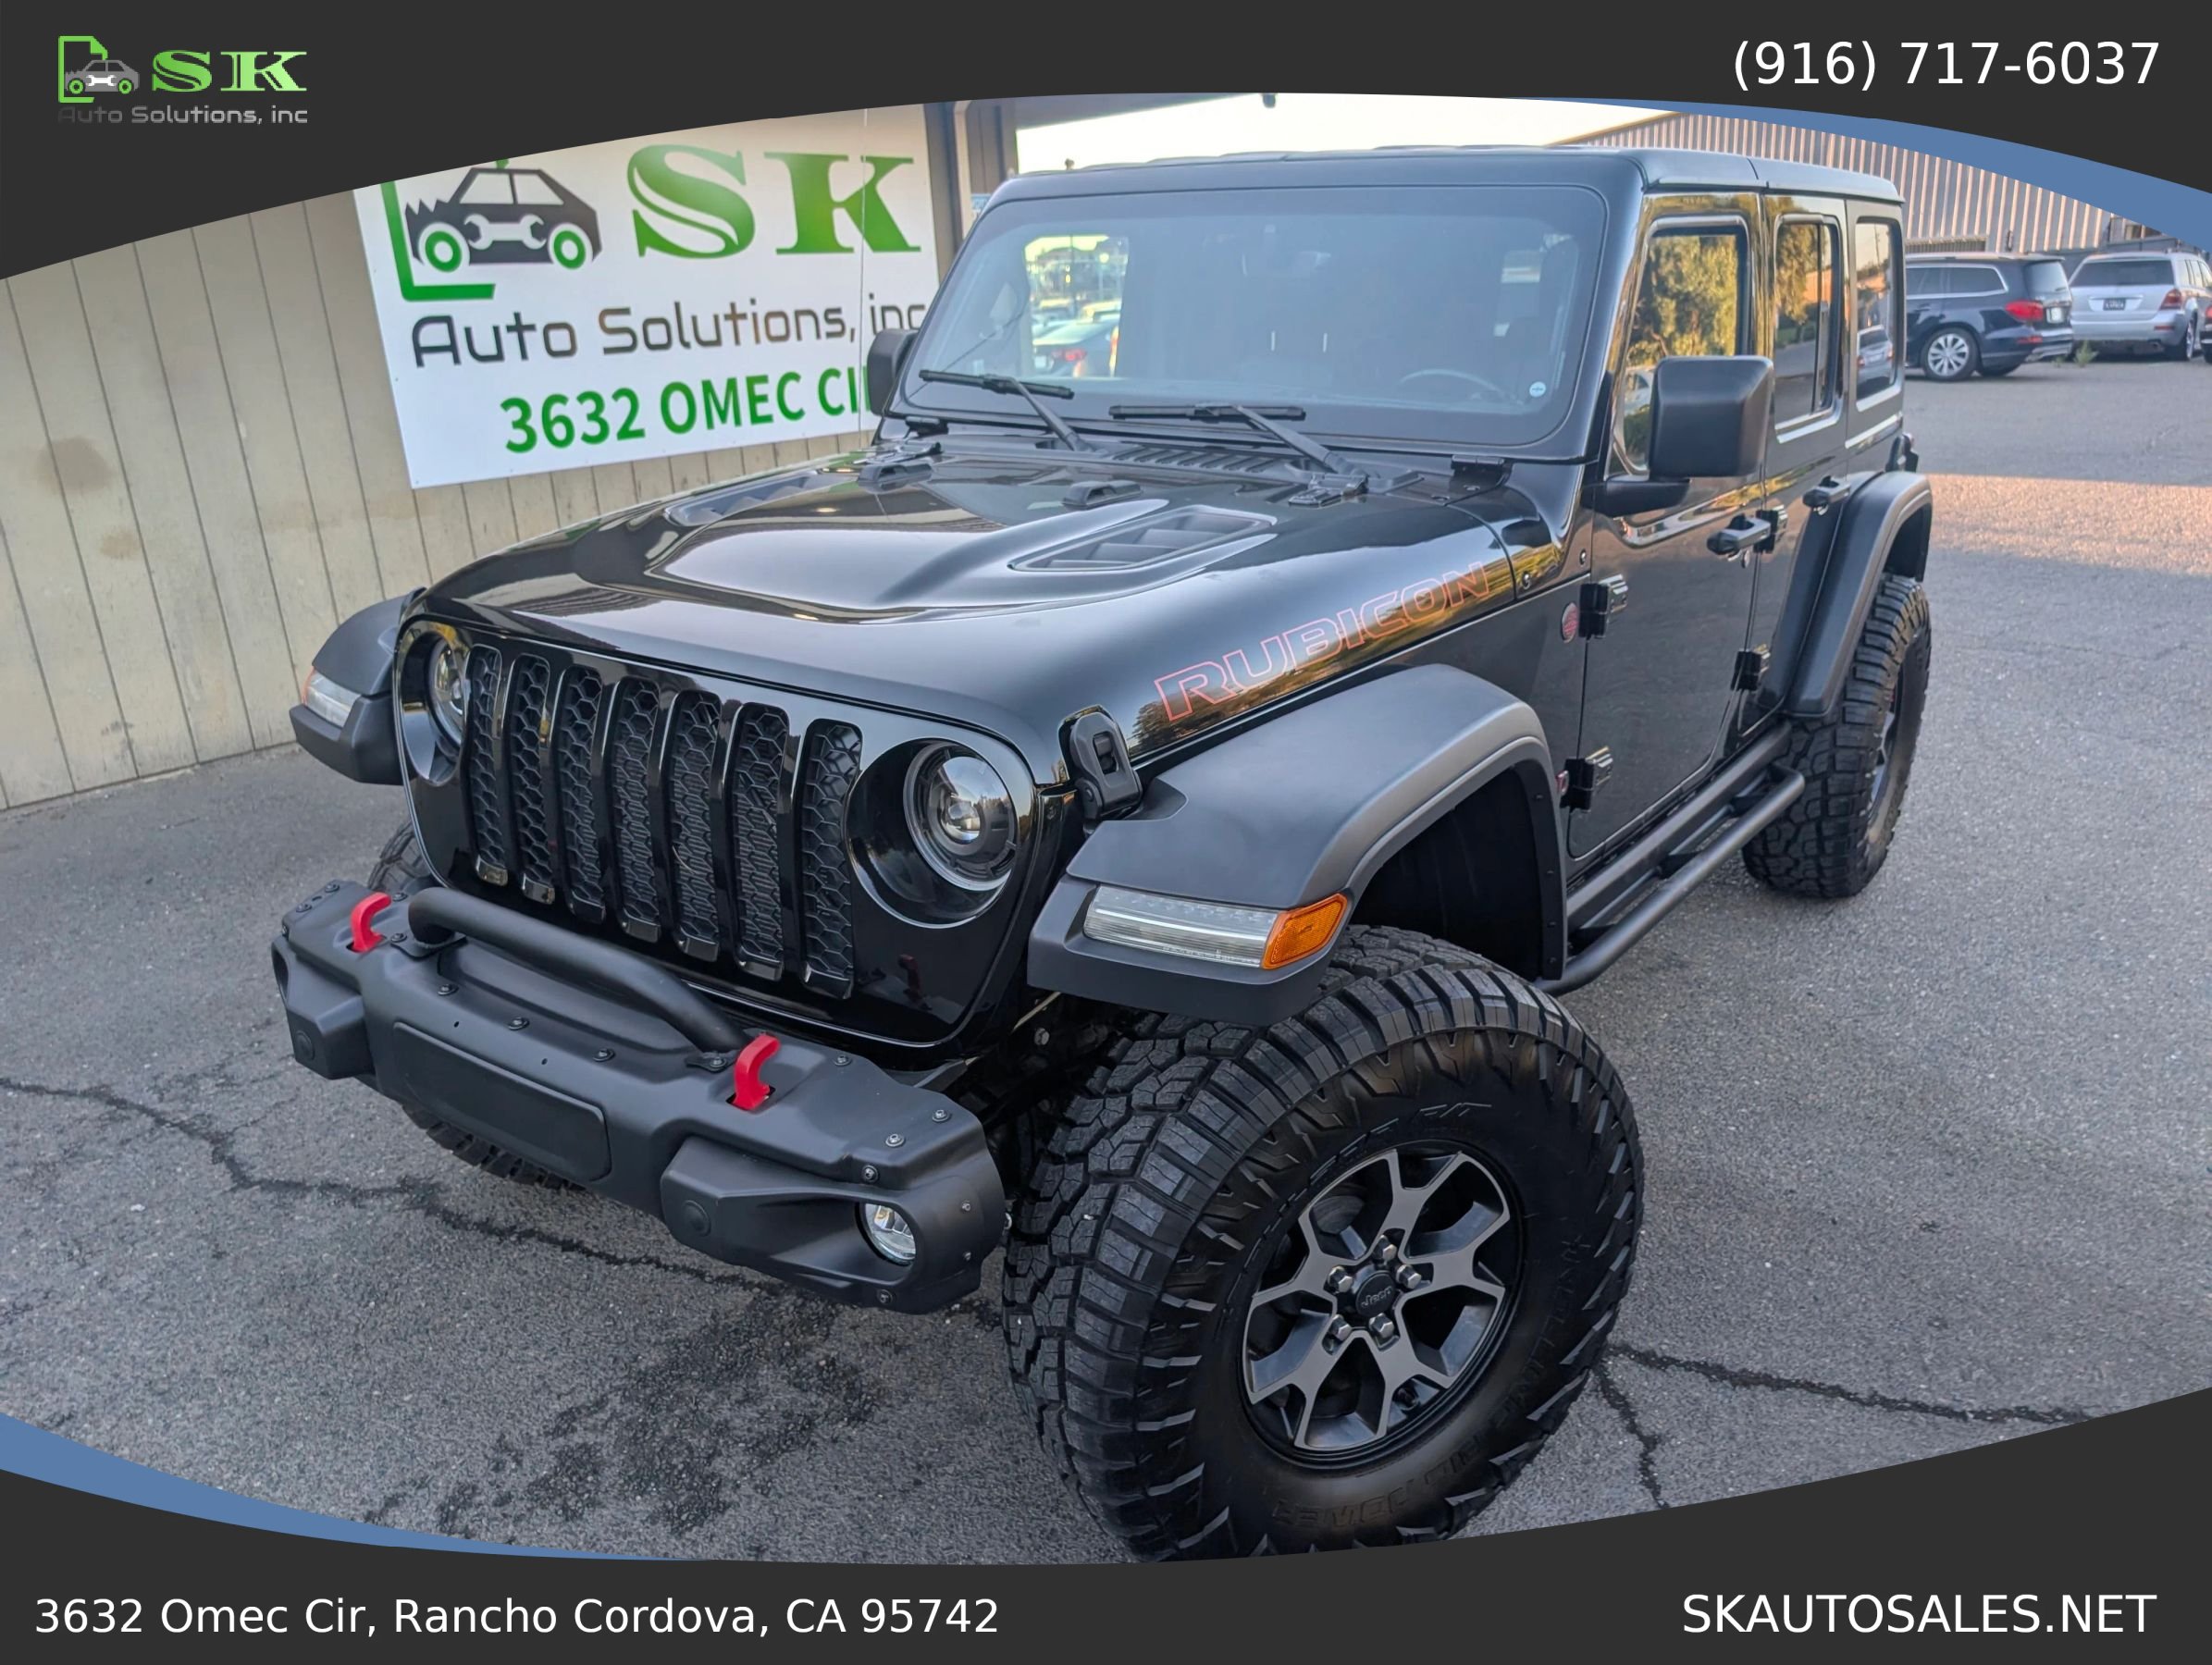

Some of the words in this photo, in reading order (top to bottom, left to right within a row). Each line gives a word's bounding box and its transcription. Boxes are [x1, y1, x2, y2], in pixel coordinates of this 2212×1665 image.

[627, 144, 921, 259] SK
[412, 312, 578, 368] Auto
[598, 298, 857, 355] Solutions,
[500, 387, 646, 453] 3632
[660, 371, 806, 435] OMEC
[1154, 561, 1489, 722] RUBICON
